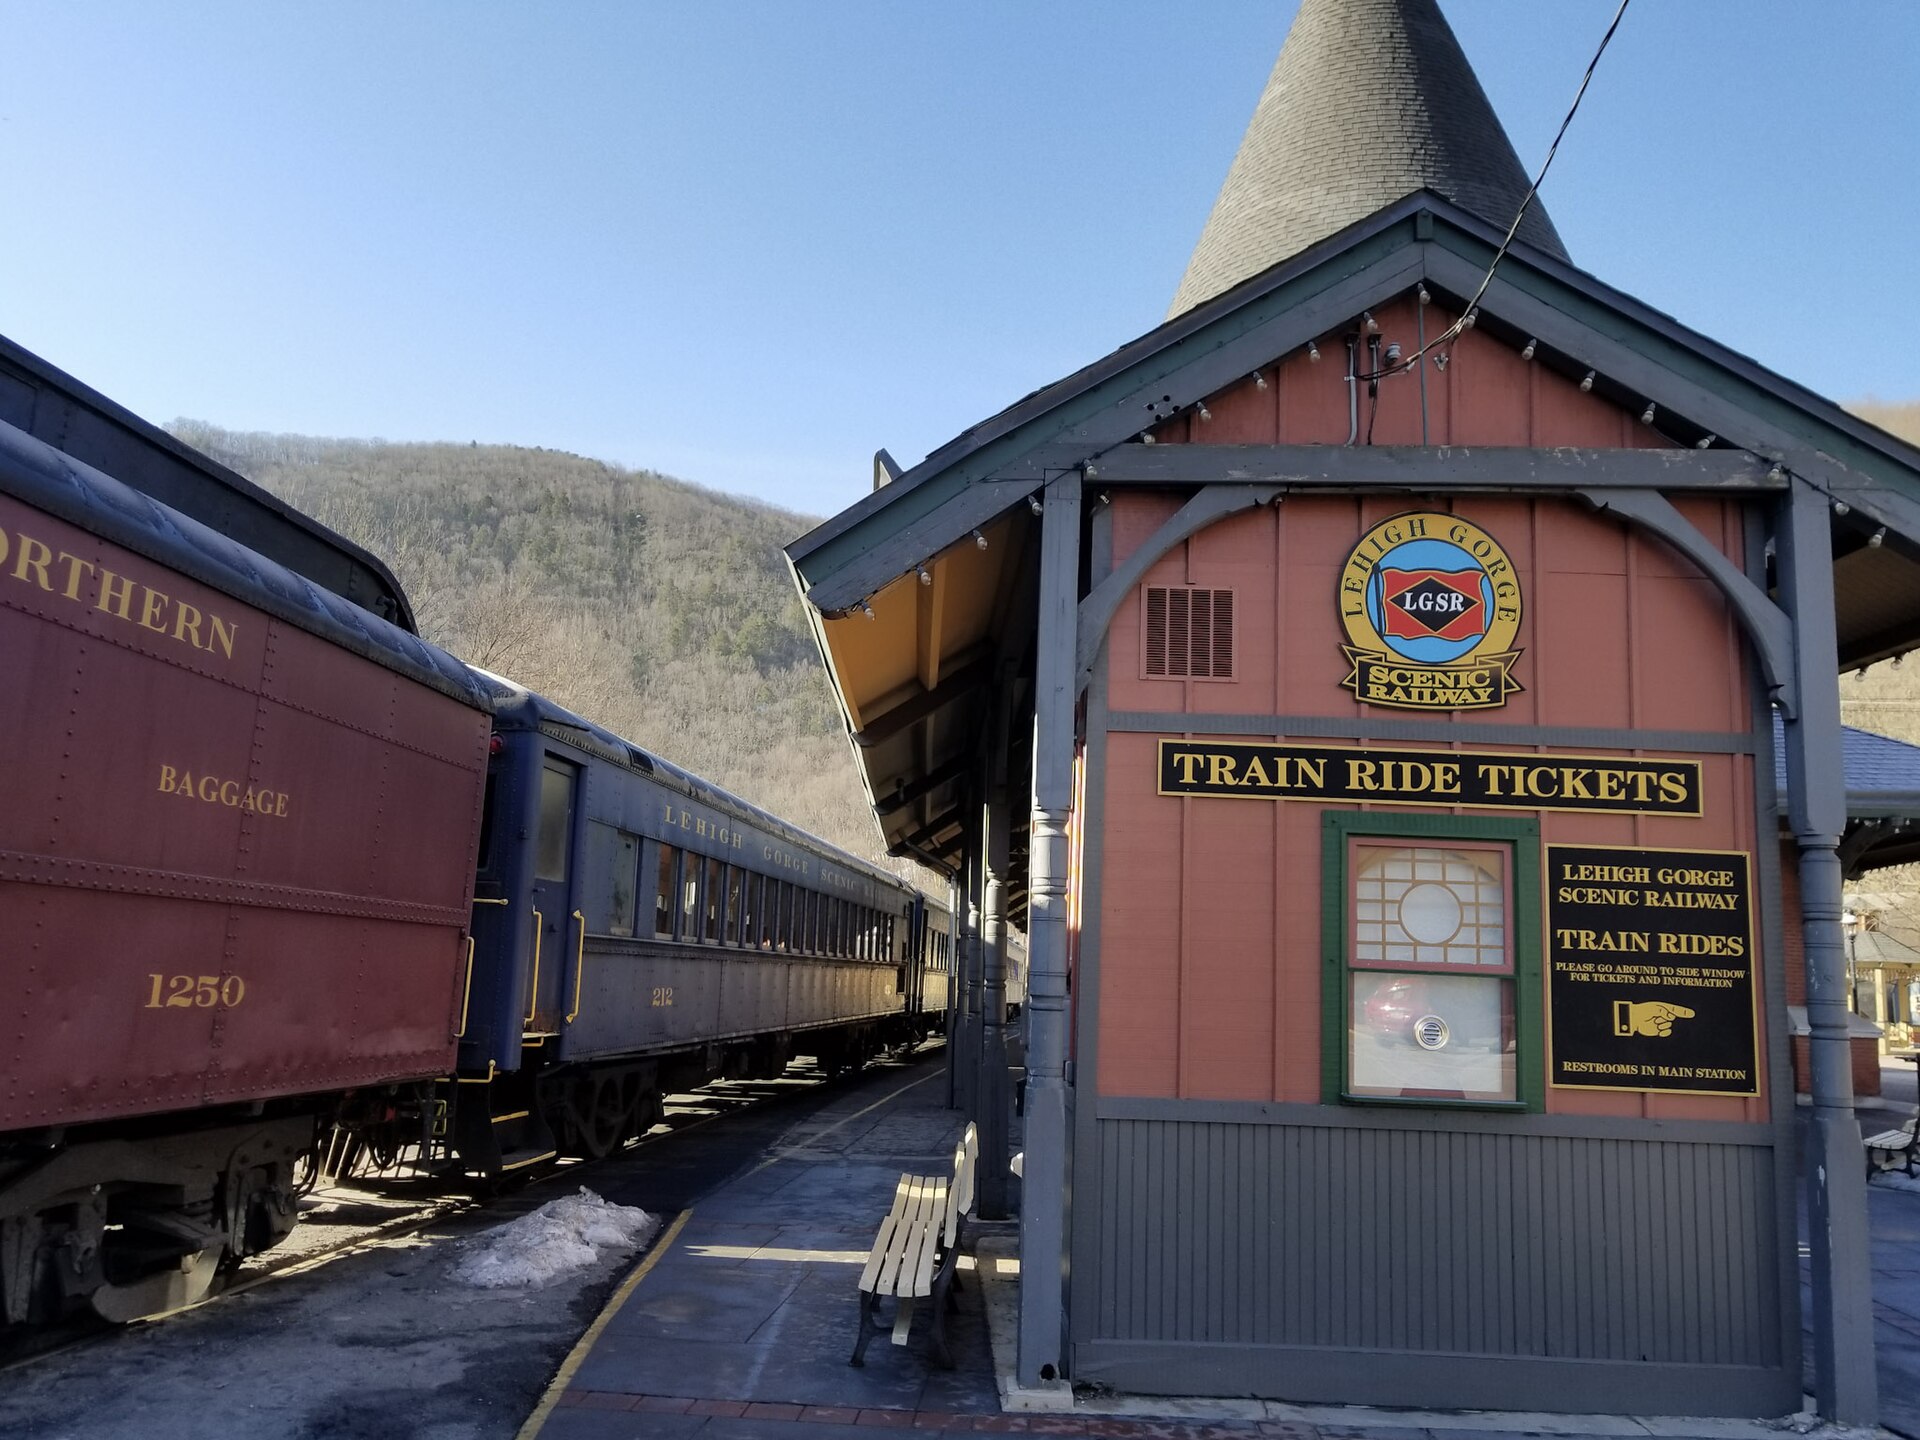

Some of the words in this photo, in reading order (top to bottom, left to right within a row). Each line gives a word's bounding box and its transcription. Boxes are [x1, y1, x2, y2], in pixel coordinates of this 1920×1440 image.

[1345, 518, 1427, 618] LEHIGH
[1449, 524, 1517, 623] GORGE
[0, 526, 239, 660] RTHERN
[1403, 591, 1465, 612] LGSR
[1369, 665, 1490, 688] SCENIC
[1366, 683, 1494, 703] RAILWAY
[1173, 752, 1328, 789] TRAIN
[1345, 758, 1462, 795] RIDE
[1478, 763, 1688, 804] TICKETS
[157, 764, 289, 818] BAGGAGE
[663, 804, 743, 849] LEHIGH
[763, 845, 809, 875] GORGE
[821, 868, 857, 892] SCENIC
[1562, 864, 1651, 884] LEHIGH
[1657, 868, 1734, 887] GORGE
[1558, 887, 1640, 906] SCENIC
[1644, 890, 1739, 911] RAILWAY
[1557, 929, 1651, 953] TRAIN
[1658, 932, 1744, 957] RIDES
[1555, 961, 1596, 973] PLEASE
[1597, 963, 1613, 973] GO
[1615, 964, 1657, 975] AROUND
[1659, 966, 1674, 976] TO
[1676, 967, 1699, 977] SIDE
[1702, 968, 1746, 980] WINDOW
[1569, 972, 1590, 982] FOR
[1592, 973, 1636, 984] TICKETS
[1638, 975, 1661, 985] AND
[1663, 976, 1733, 988] INFORMATION
[144, 973, 246, 1009] 1250
[652, 987, 673, 1007] 212
[1562, 1061, 1639, 1075] RESTROOMS
[1641, 1064, 1656, 1076] IN
[1658, 1066, 1693, 1078] MAIN
[1695, 1067, 1747, 1080] STATION
